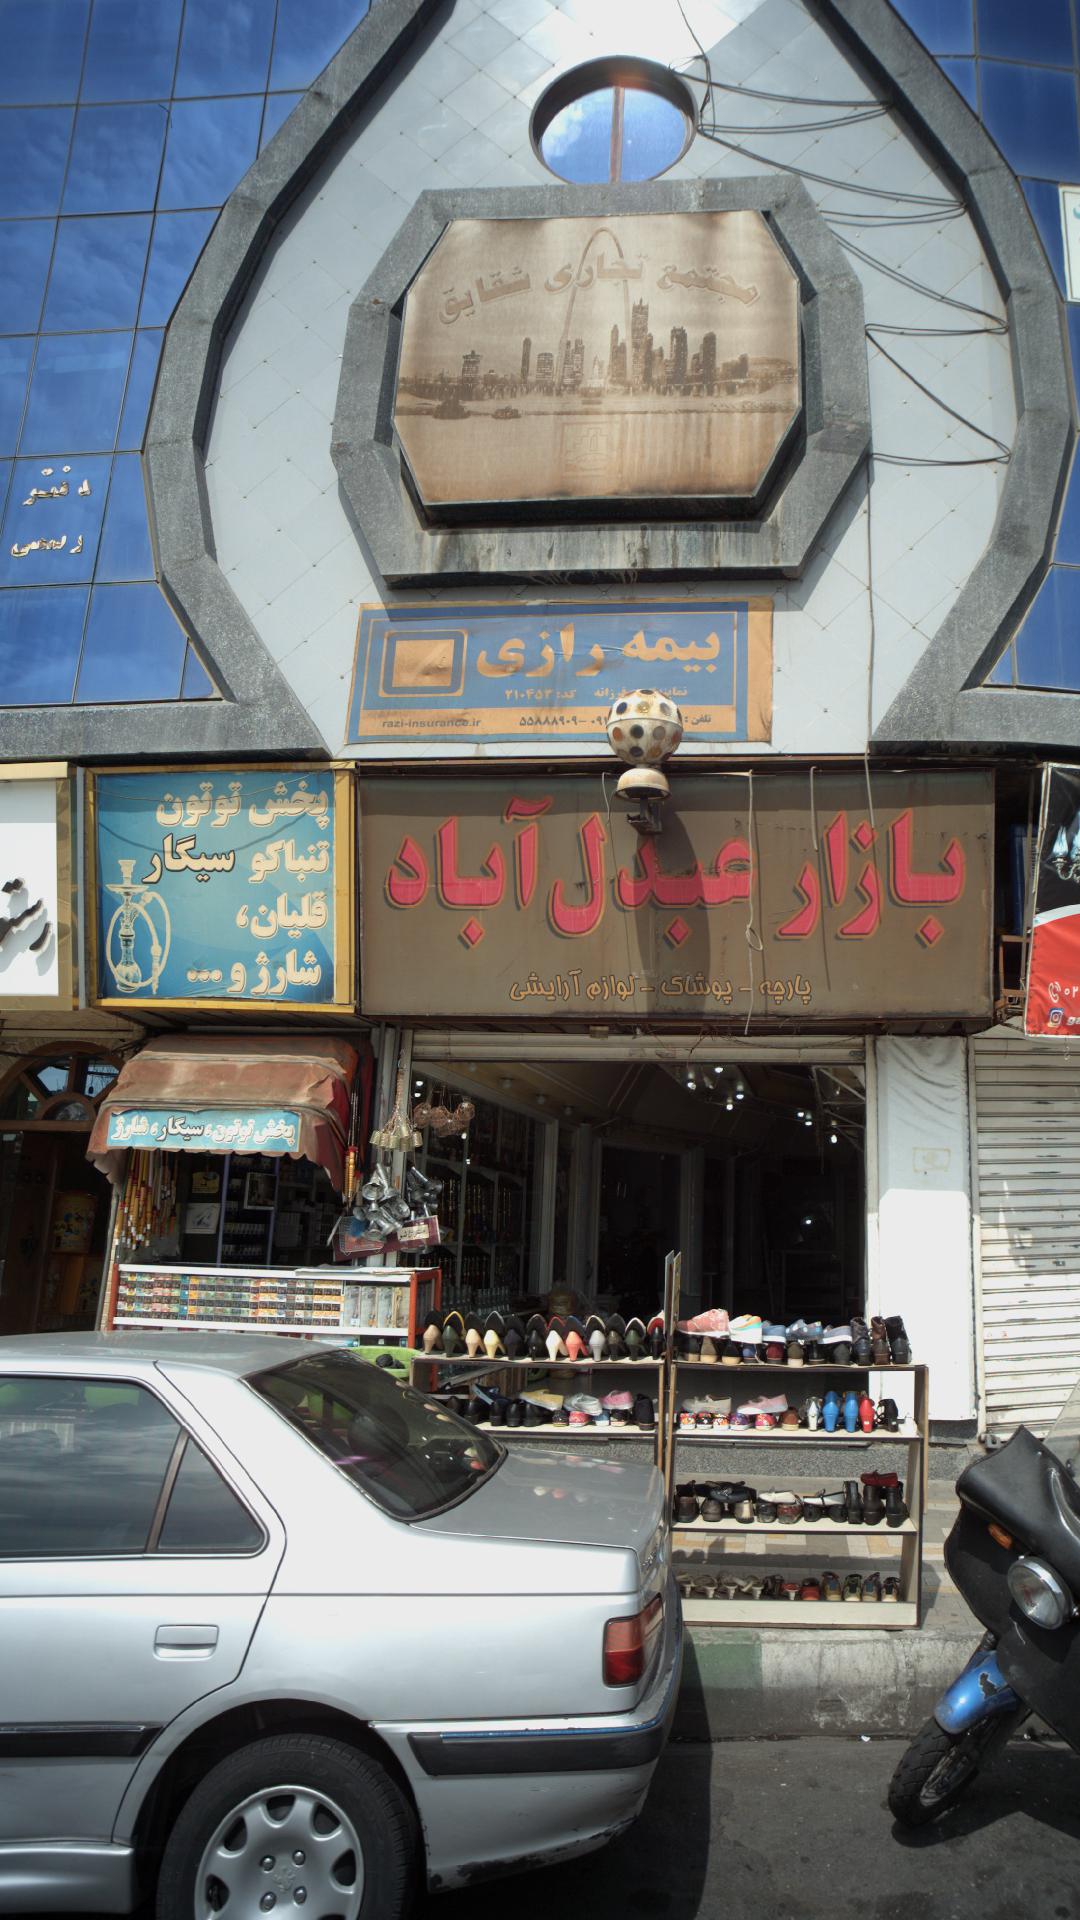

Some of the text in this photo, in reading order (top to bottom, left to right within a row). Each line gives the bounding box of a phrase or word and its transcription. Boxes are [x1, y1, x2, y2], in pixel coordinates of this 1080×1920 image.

[438, 264, 533, 326] شقایق
[476, 622, 721, 678] بیمه رازی
[382, 717, 482, 729] razi-insurance.ir
[155, 780, 330, 830] پخش توتون
[141, 832, 330, 885] تنباکو سیگار
[386, 795, 966, 947] بازار عبدل آباد
[250, 949, 322, 995] شارژ
[508, 968, 584, 1002] آرایشی
[586, 974, 639, 1001] لوازم
[660, 972, 733, 1006] پوشاک
[758, 974, 813, 1005] پارچه
[111, 1115, 150, 1141] شارژ
[252, 1118, 296, 1146] پخش
